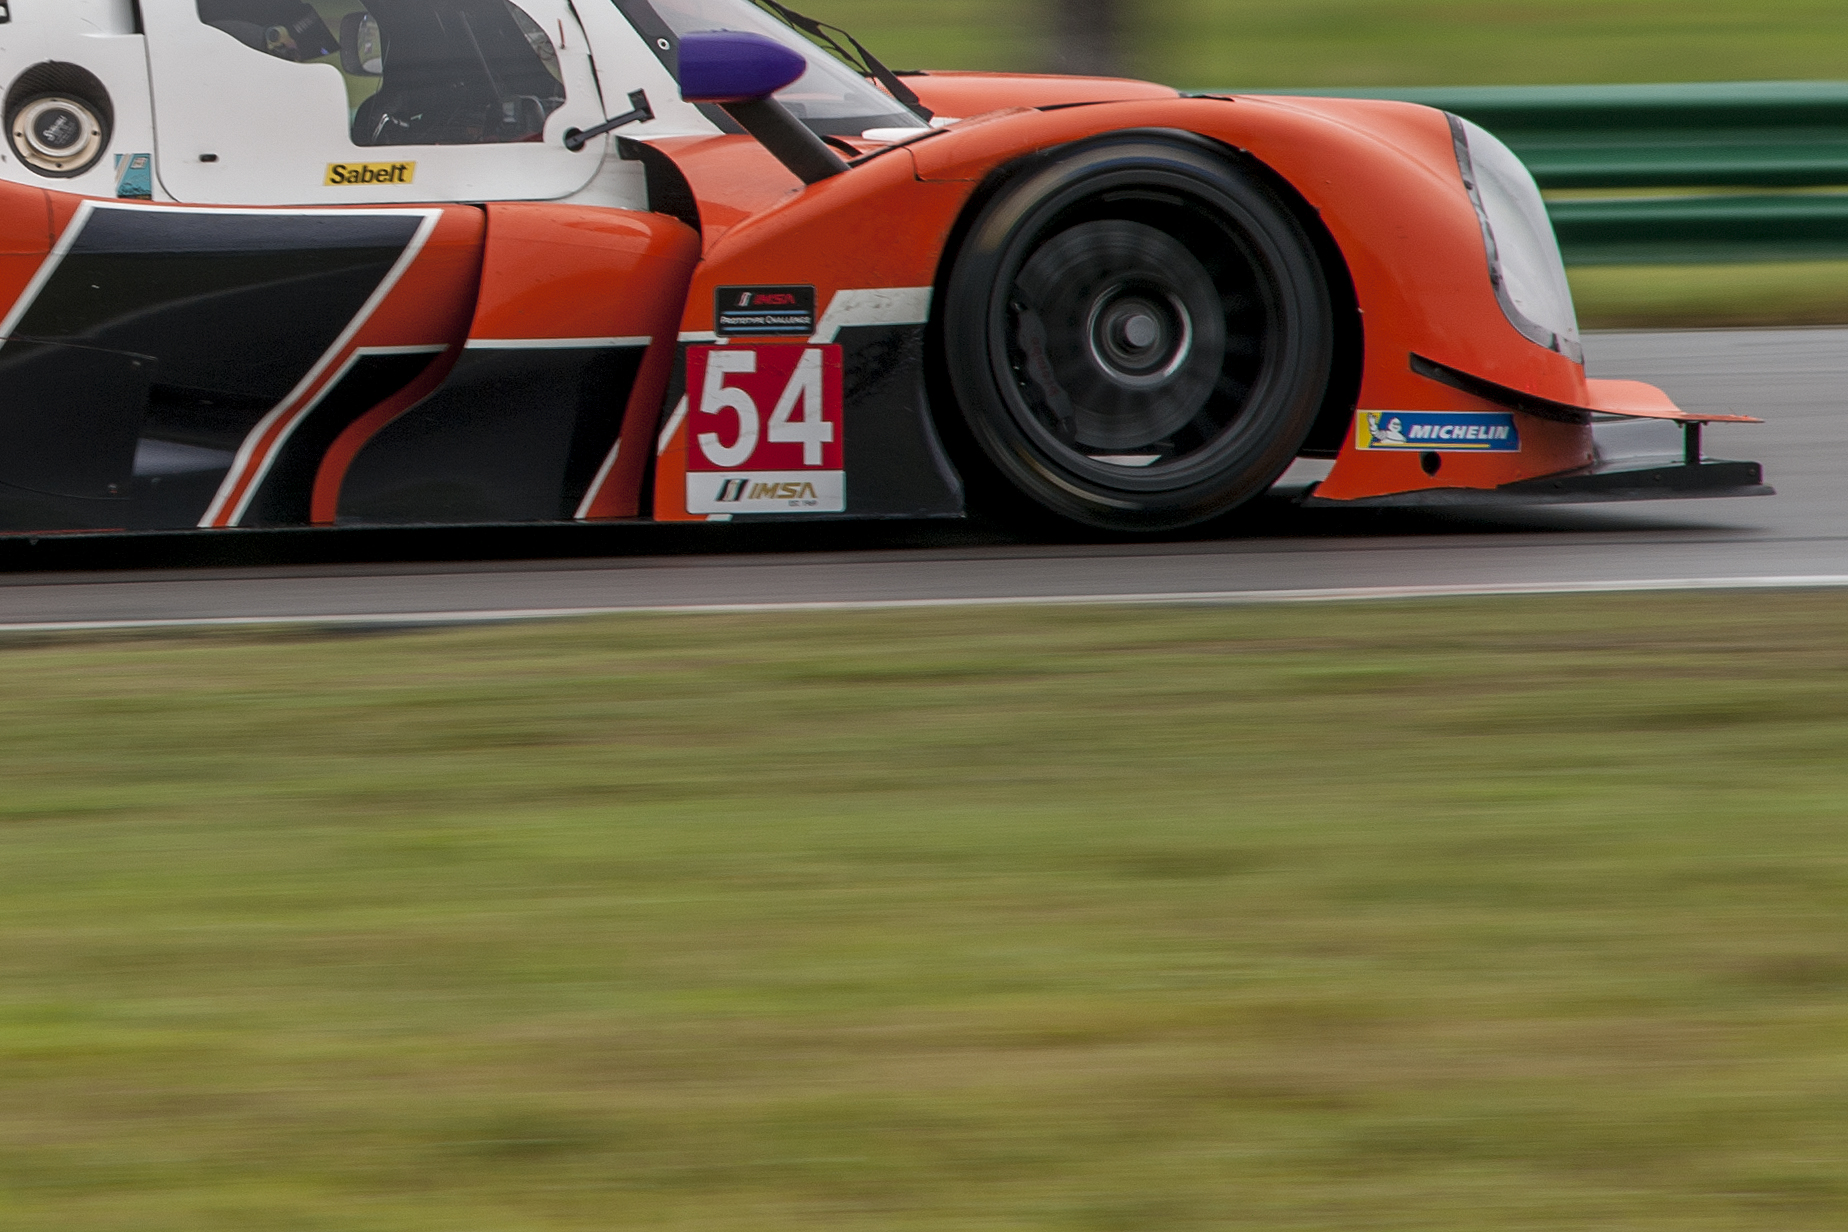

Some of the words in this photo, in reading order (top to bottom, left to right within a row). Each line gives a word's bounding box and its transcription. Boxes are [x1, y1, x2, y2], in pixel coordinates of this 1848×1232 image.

[329, 164, 407, 184] Sabelt
[697, 348, 834, 467] 54
[1408, 424, 1510, 440] MICHELIN
[748, 482, 818, 500] IMSA
